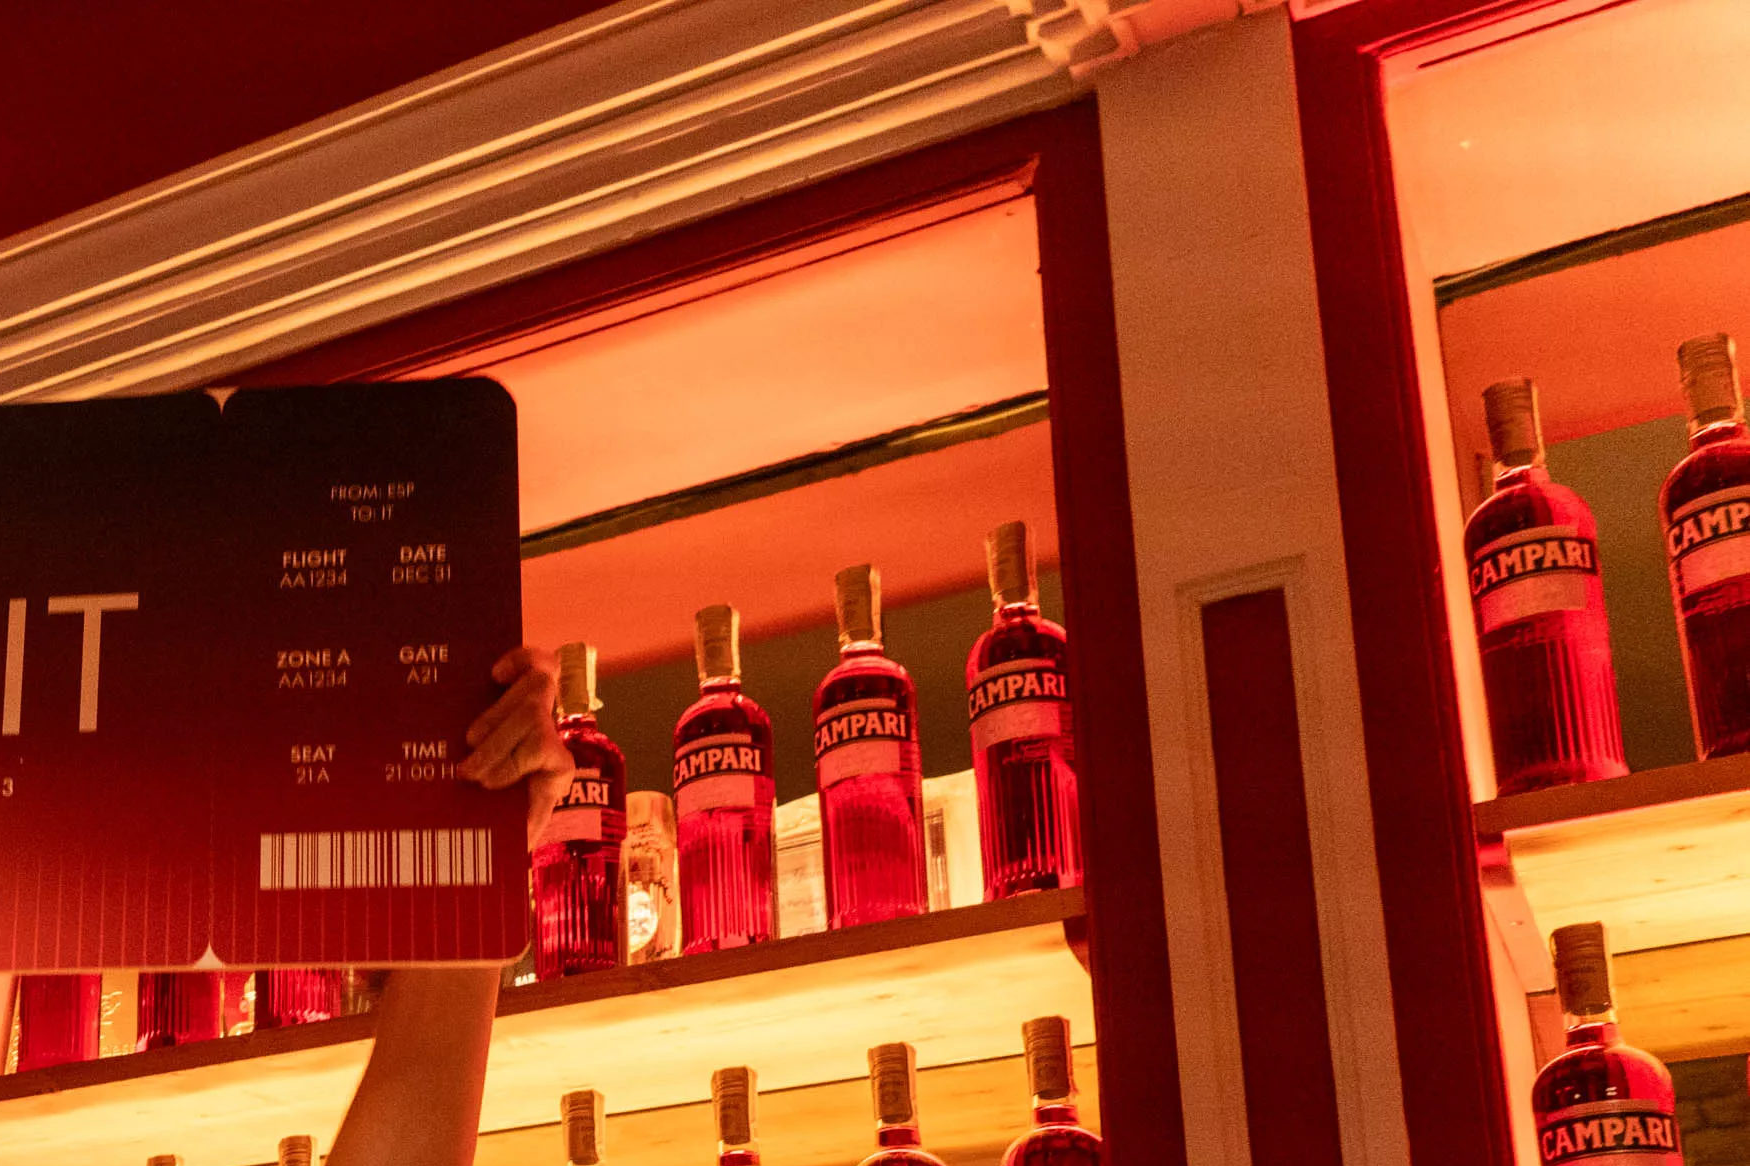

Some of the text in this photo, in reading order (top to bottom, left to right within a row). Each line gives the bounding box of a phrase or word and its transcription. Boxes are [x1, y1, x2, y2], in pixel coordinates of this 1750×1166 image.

[1668, 501, 1750, 557] CAMP
[282, 548, 347, 569] FLIGHT
[400, 543, 447, 564] DATE
[1470, 539, 1592, 595] CAMPARI
[392, 563, 452, 585] DEC 31
[2, 592, 139, 736] IT
[277, 647, 351, 669] ZONE A
[399, 644, 449, 665] GATE
[969, 672, 1067, 718] CAMPARI
[402, 740, 447, 760] TIME
[815, 711, 906, 757] CAMPARI
[290, 744, 336, 764] SEAT
[674, 746, 761, 789] CAMPARI
[1542, 1116, 1674, 1161] CAMPARI
